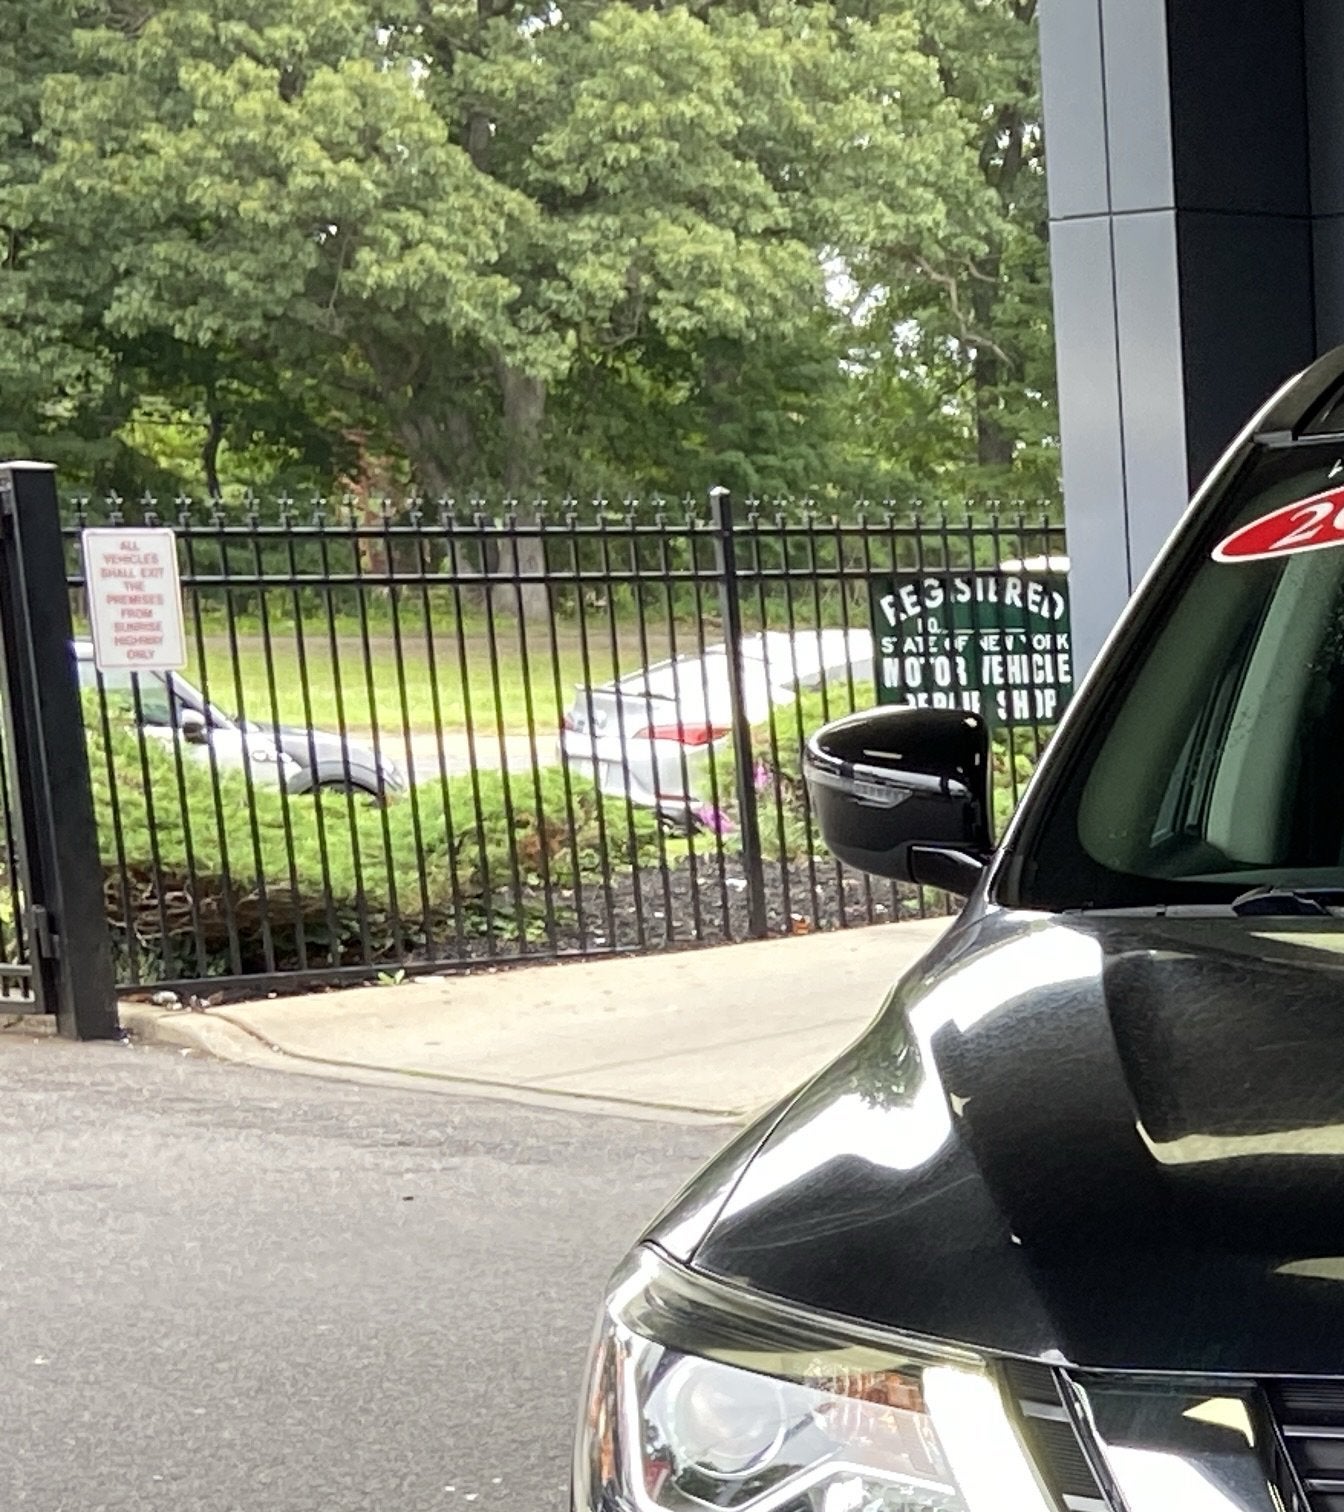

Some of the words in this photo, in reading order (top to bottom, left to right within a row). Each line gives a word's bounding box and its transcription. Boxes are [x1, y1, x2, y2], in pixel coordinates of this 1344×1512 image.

[120, 541, 139, 551] ALL
[103, 553, 159, 564] VEHICLES
[100, 567, 136, 578] SHALL
[140, 567, 164, 578] EXIT
[124, 581, 145, 592] THE
[106, 594, 164, 605] PREMISES
[880, 576, 1065, 627] REGSTERED
[121, 608, 153, 618] FROM
[114, 621, 163, 632] SUNRISE
[114, 636, 163, 646] HIGHWAY
[1019, 633, 1070, 651] OK
[127, 649, 155, 660] ONLY
